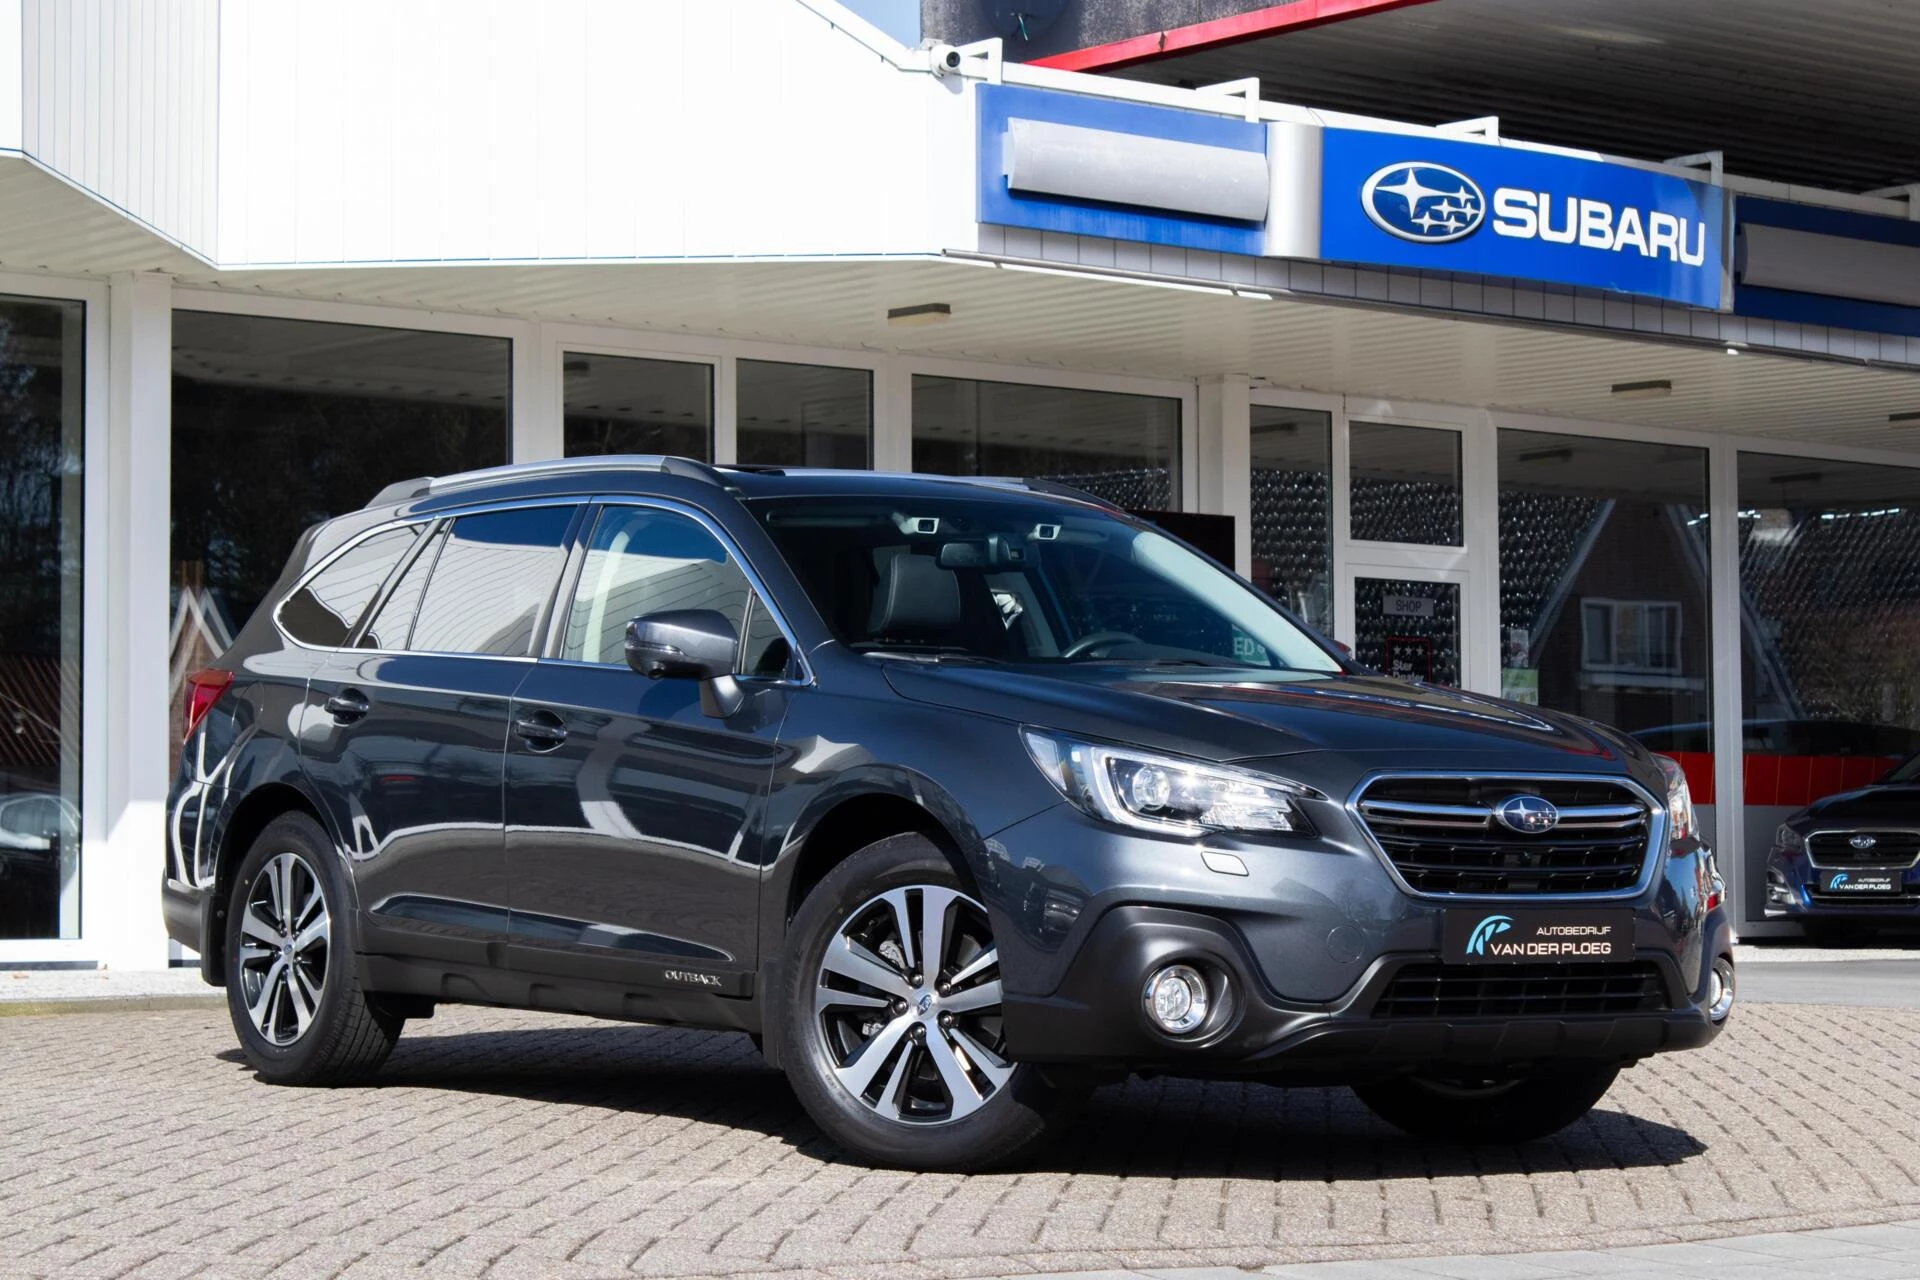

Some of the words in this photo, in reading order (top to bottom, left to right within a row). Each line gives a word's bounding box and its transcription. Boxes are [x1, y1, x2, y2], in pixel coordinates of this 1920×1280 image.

[1493, 187, 1705, 266] SUBARU
[1395, 599, 1422, 612] SHOP
[1392, 659, 1413, 671] Star
[1536, 926, 1612, 936] AUTOBEDRIJF
[1490, 943, 1524, 956] VAN
[1527, 943, 1559, 955] DER
[1561, 942, 1612, 955] PLOEG
[664, 969, 722, 987] OUTBACK
